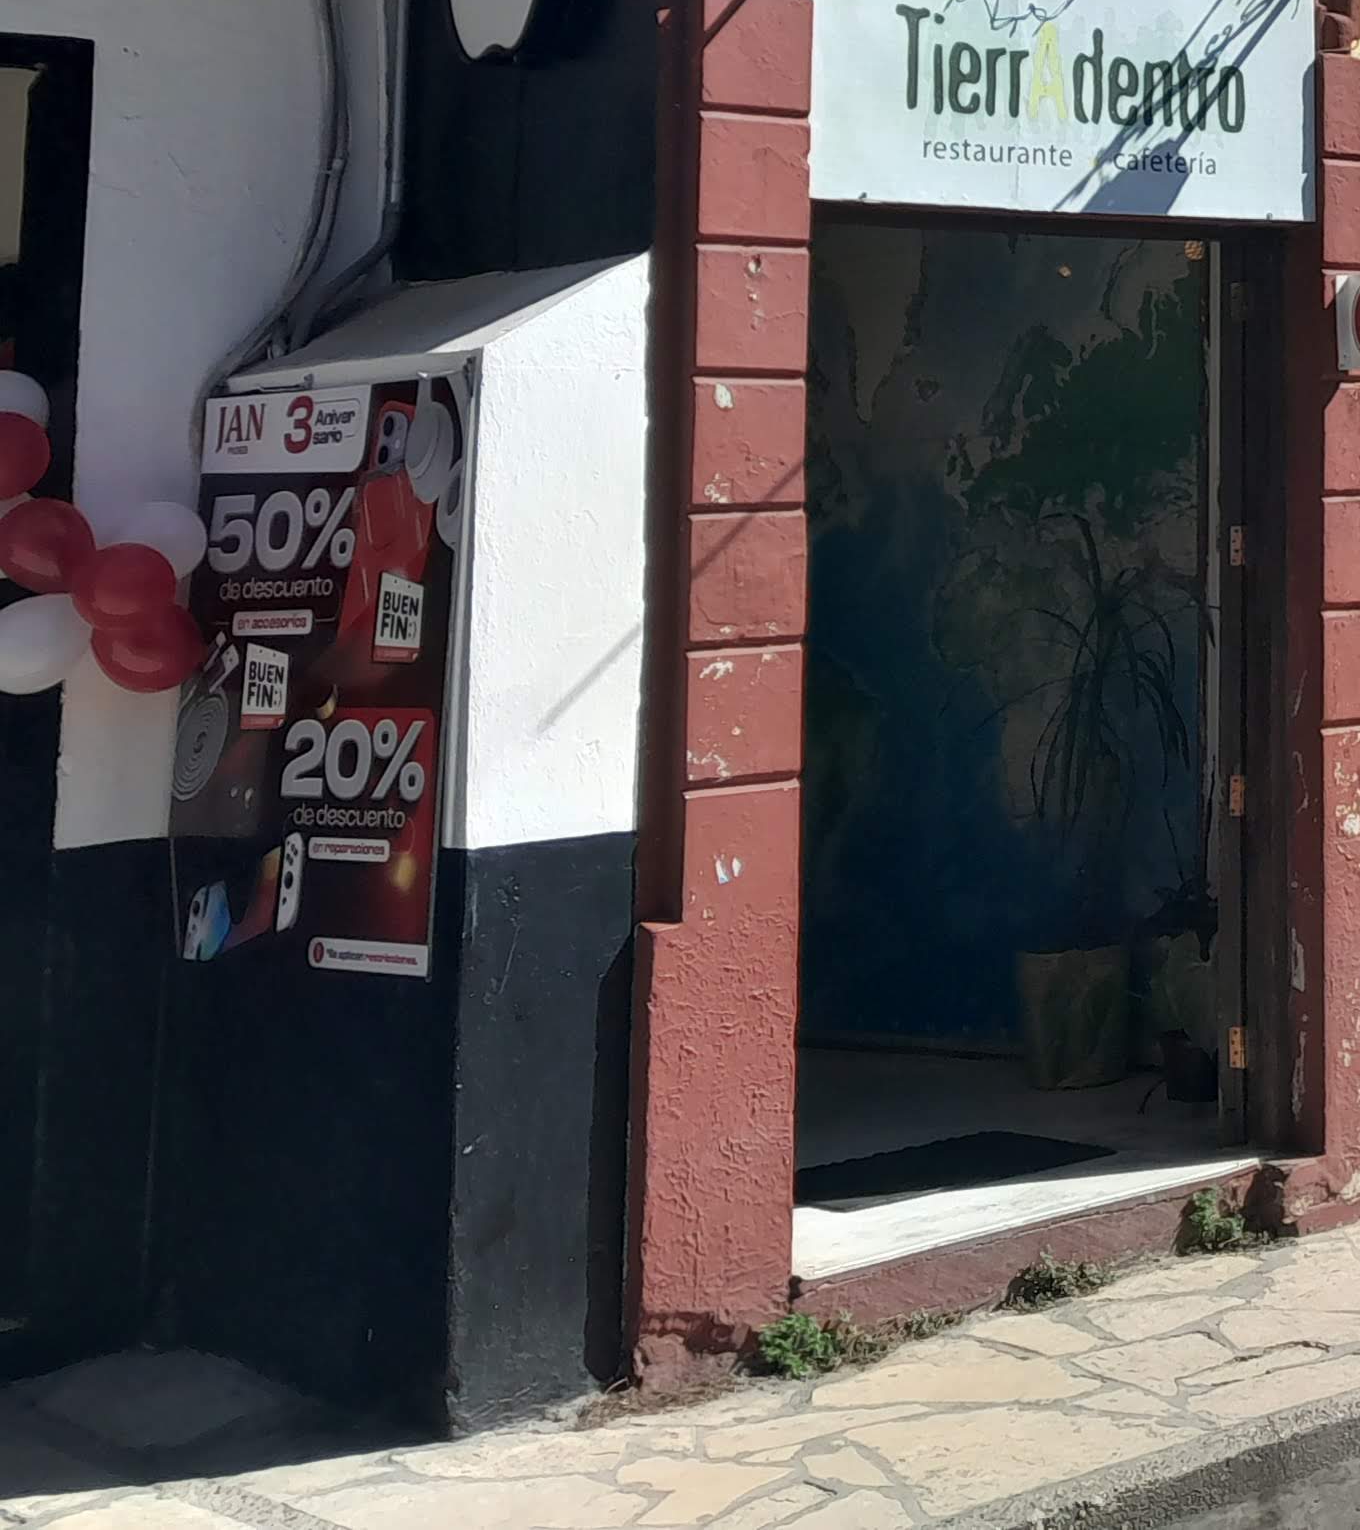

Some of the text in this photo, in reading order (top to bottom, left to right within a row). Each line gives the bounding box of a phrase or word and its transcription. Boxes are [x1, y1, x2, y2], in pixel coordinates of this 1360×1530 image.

[922, 136, 1073, 168] restaurante
[215, 403, 266, 454] JAN
[284, 395, 314, 454] 3
[315, 409, 356, 427] Aniver
[208, 487, 356, 572] 50%
[219, 577, 333, 600] de descuento
[383, 590, 419, 617] BUEN
[249, 660, 285, 685] BUEN
[280, 719, 426, 802] 20%
[293, 802, 406, 828] de descuento
